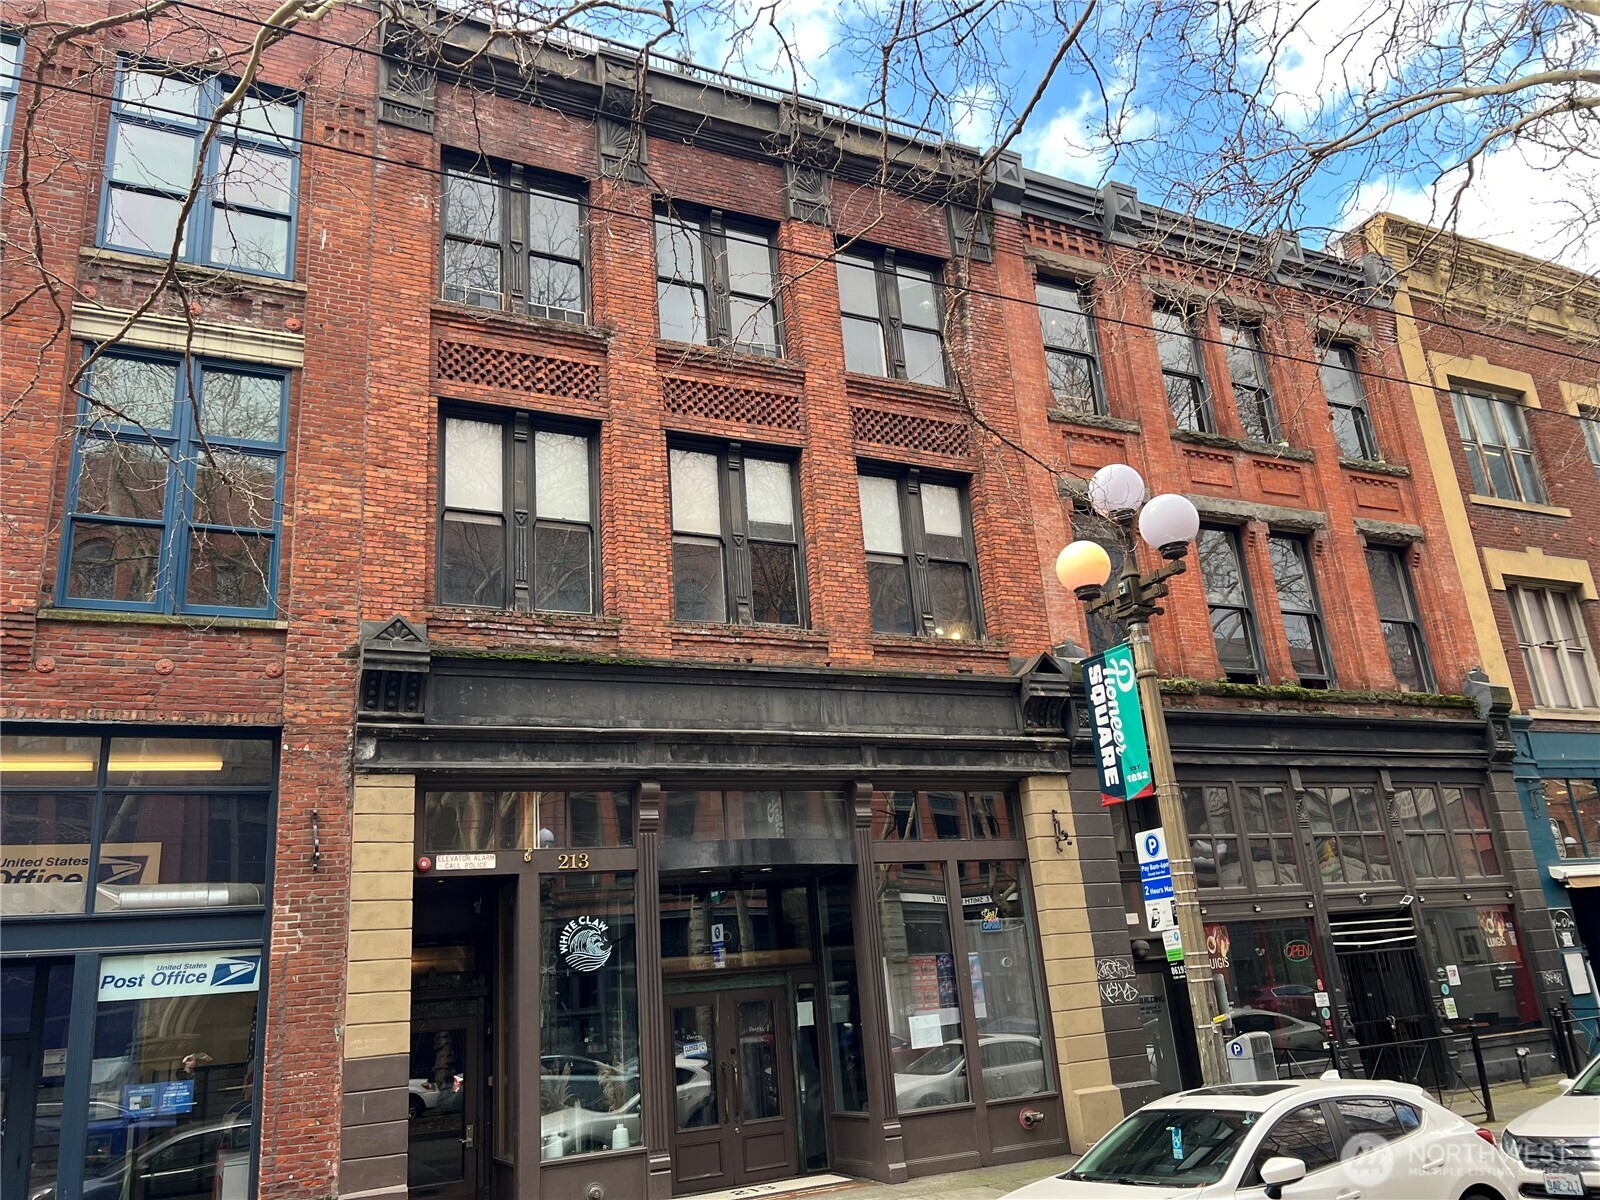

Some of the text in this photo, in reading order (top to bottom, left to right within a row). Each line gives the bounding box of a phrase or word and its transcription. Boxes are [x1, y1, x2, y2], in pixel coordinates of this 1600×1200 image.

[1103, 658, 1135, 757] Pioneer
[1088, 664, 1119, 787] SQUARE
[1127, 771, 1149, 783] 1852
[1148, 838, 1157, 853] P
[0, 857, 89, 867] United States
[437, 855, 471, 863] ELEVATOR
[557, 853, 590, 870] 213
[1141, 865, 1149, 873] Pay
[1144, 886, 1150, 896] 2
[1150, 887, 1164, 895] Hours
[559, 916, 609, 955] WHITE CLAW
[1286, 944, 1310, 958] OPEN
[156, 963, 182, 971] United
[100, 971, 208, 990] Post Office
